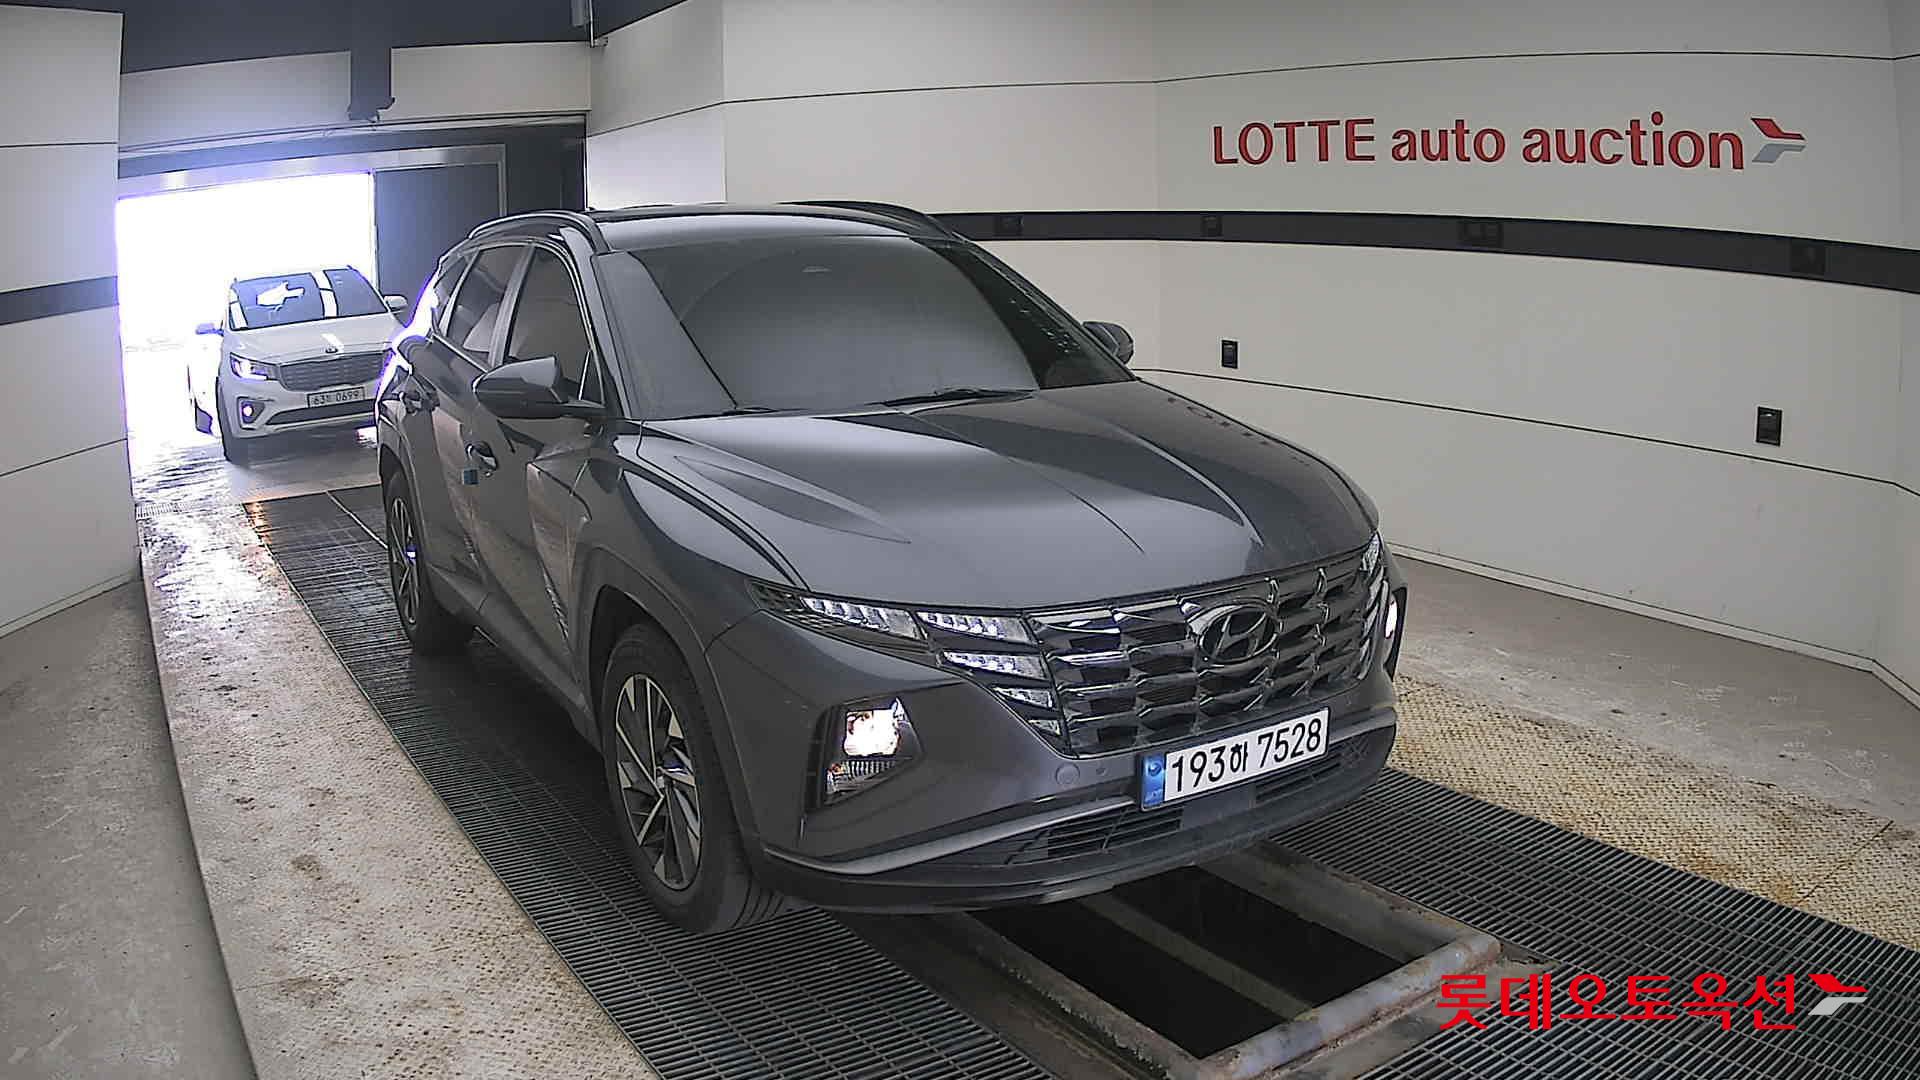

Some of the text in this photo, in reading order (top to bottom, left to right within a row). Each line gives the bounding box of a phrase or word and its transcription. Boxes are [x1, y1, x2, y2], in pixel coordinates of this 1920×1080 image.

[1212, 112, 1745, 170] LOTTE auto auction
[1171, 718, 1322, 793] 193하 7528
